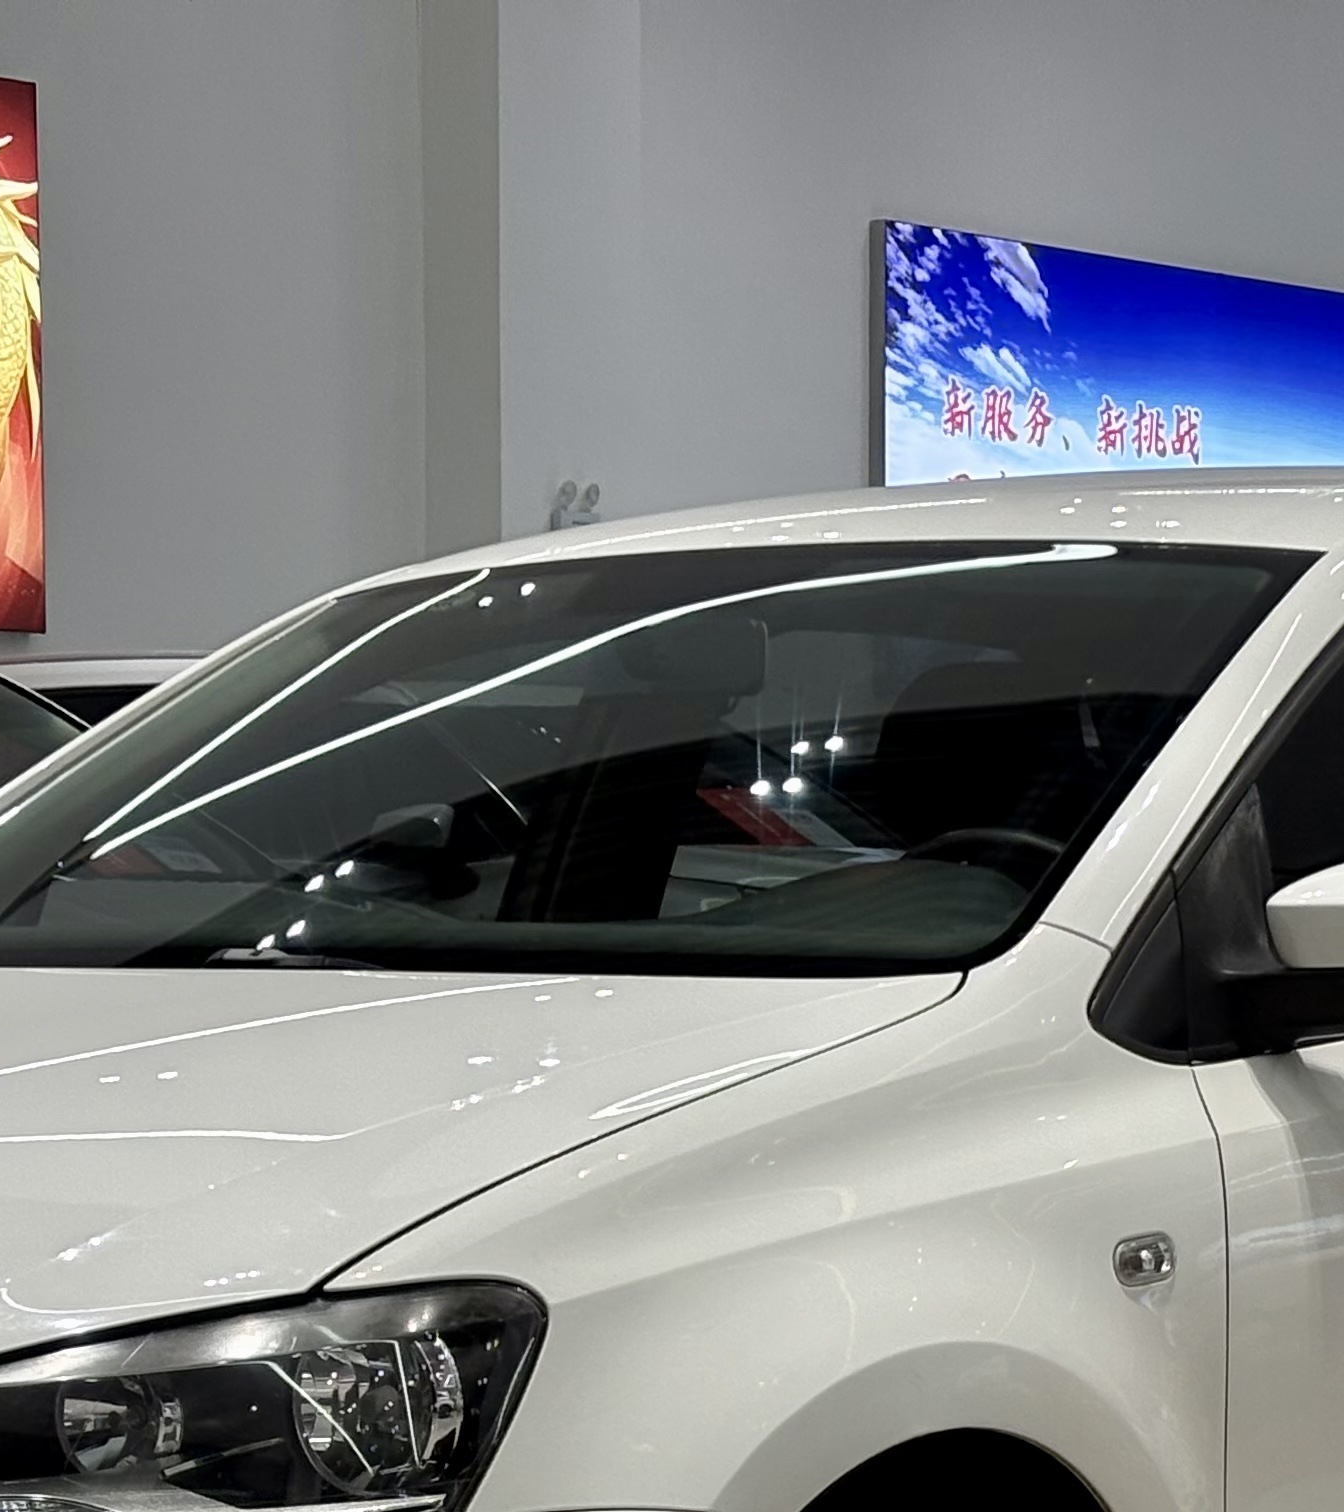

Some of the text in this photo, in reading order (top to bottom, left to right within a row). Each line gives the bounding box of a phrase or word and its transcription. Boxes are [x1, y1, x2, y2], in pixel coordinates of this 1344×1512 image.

[941, 376, 1203, 466] 新服务、新挑战
